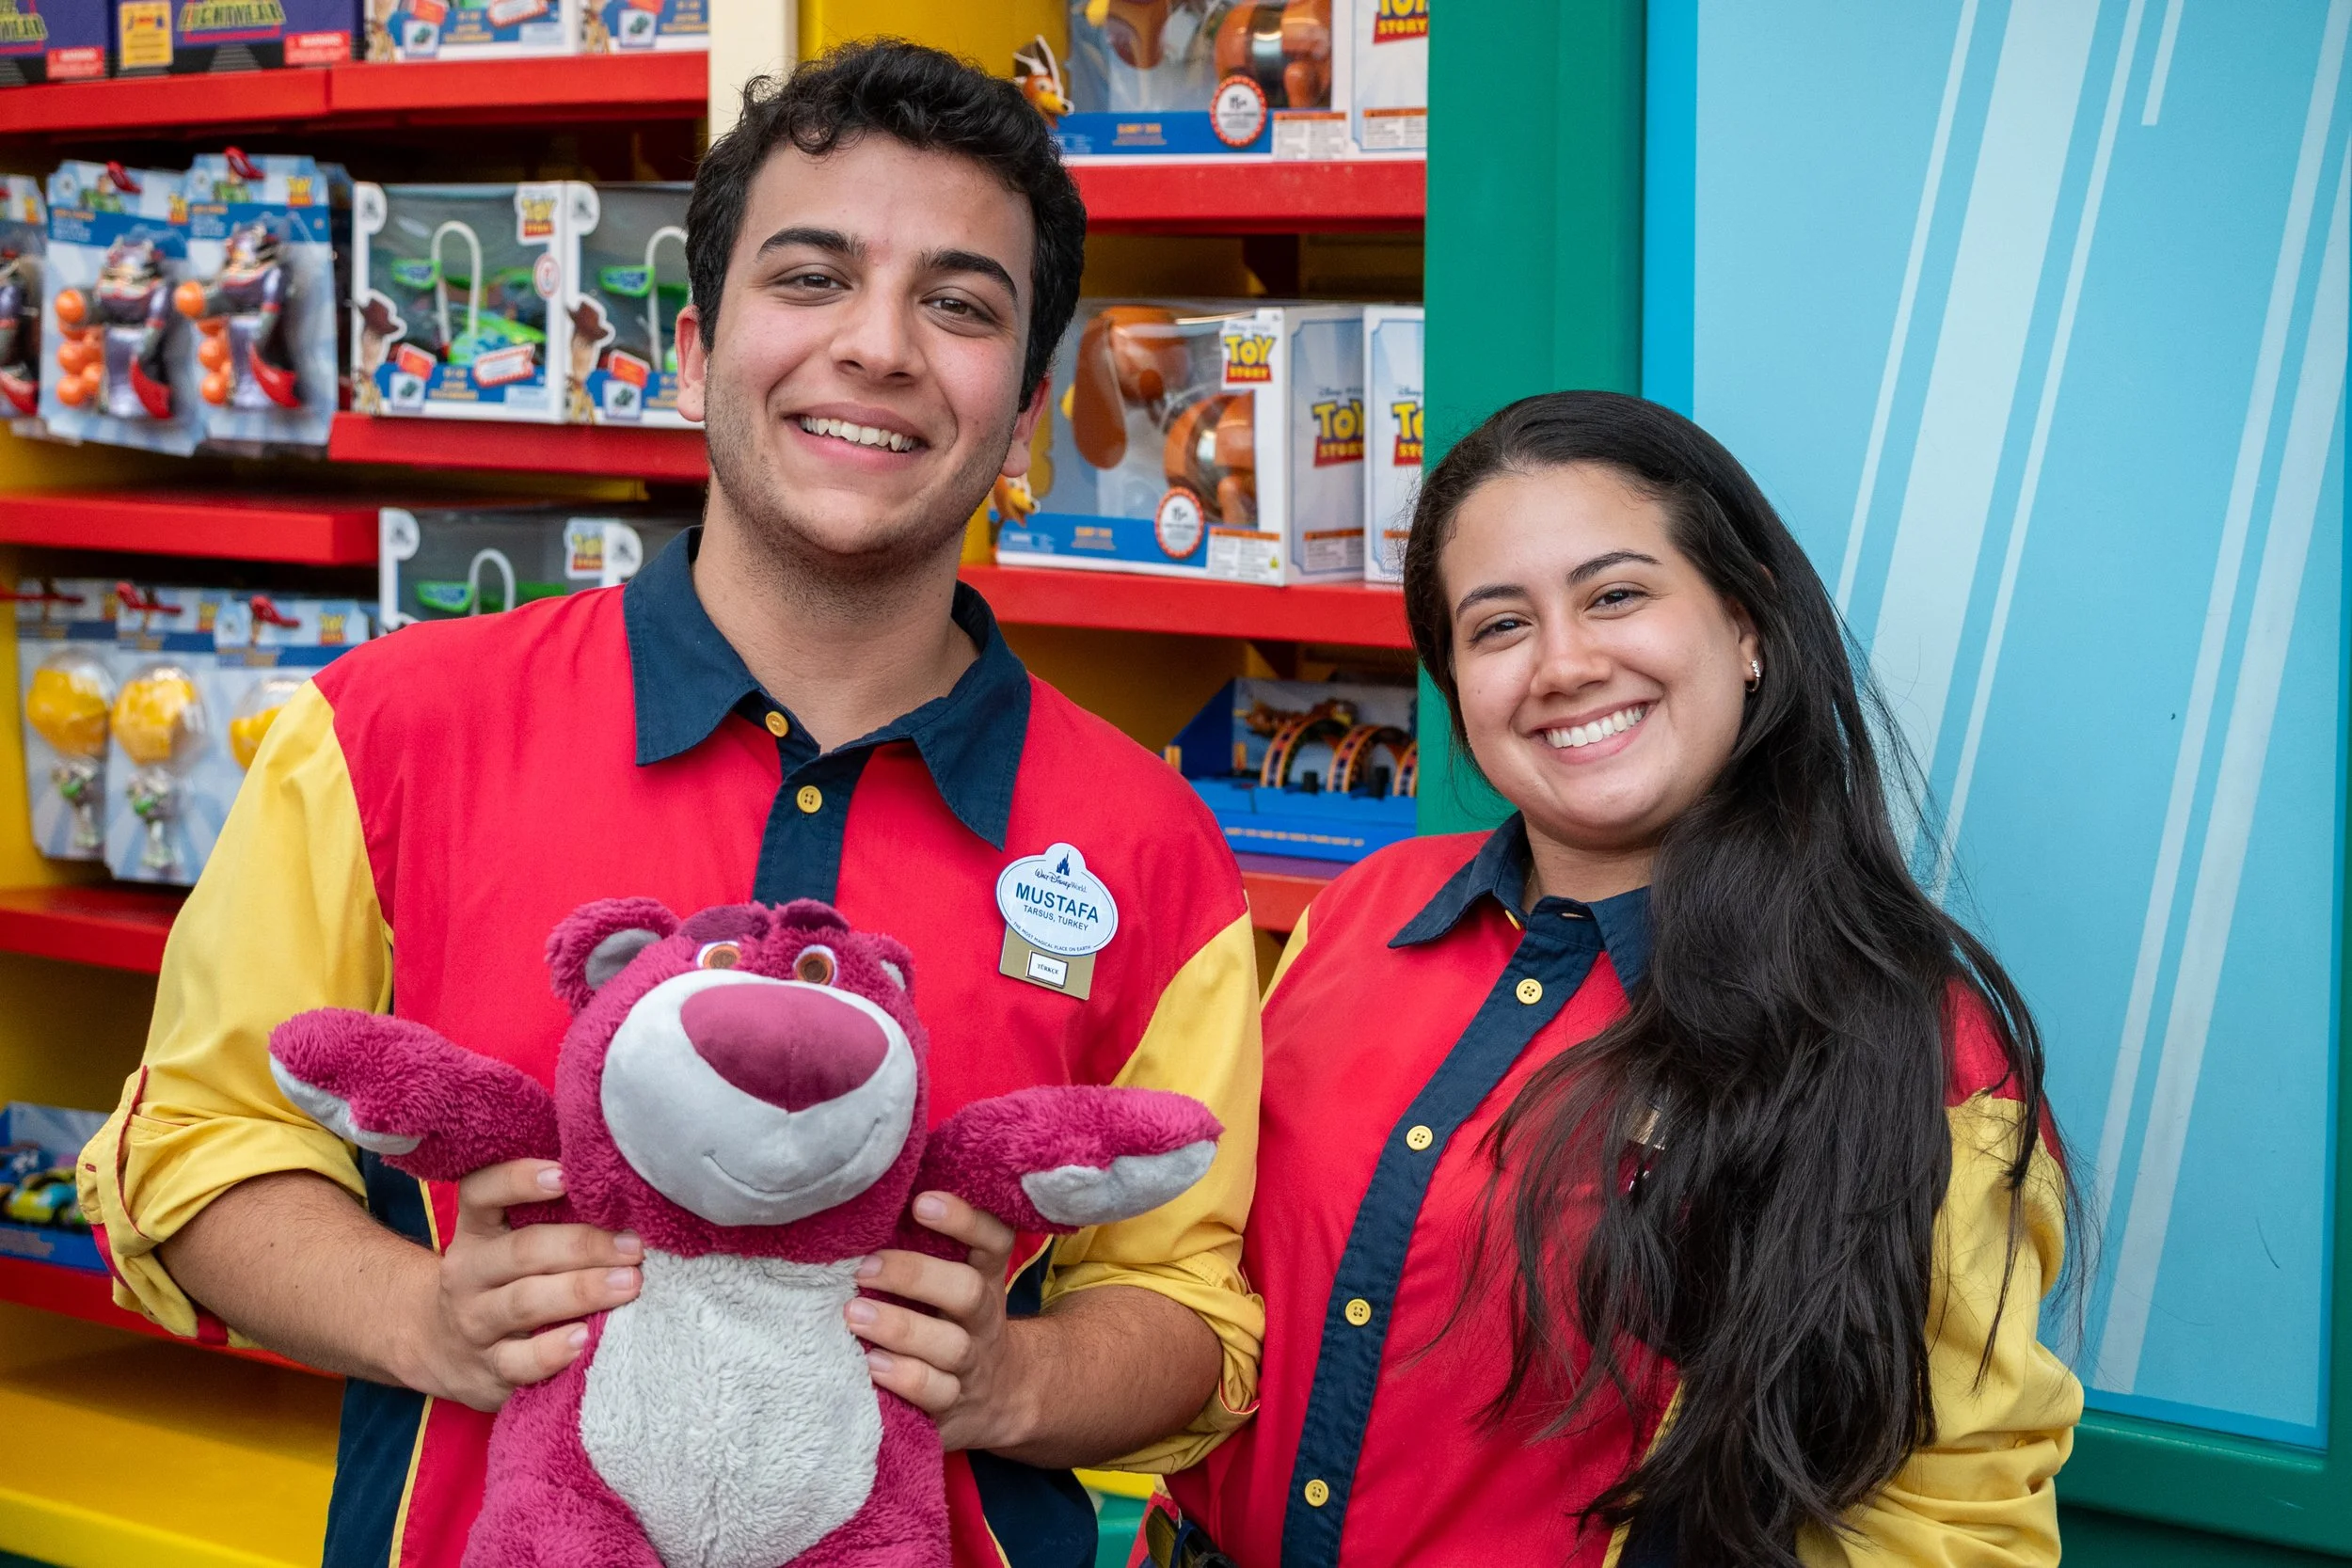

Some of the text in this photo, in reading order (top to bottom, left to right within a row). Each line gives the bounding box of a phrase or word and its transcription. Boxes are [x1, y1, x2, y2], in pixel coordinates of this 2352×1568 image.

[1377, 18, 1427, 34] STORY
[1224, 333, 1277, 365] TOY
[1229, 366, 1268, 377] STORY
[1391, 401, 1423, 442] TO
[1034, 867, 1049, 880] Walt
[1048, 871, 1071, 890] Disney
[1016, 882, 1099, 924] MUSTAFA
[1024, 904, 1089, 931] TARSUS, TURKEY
[1013, 921, 1022, 931] THE
[1022, 928, 1034, 939] MOST
[1034, 937, 1054, 948] MAGICAL
